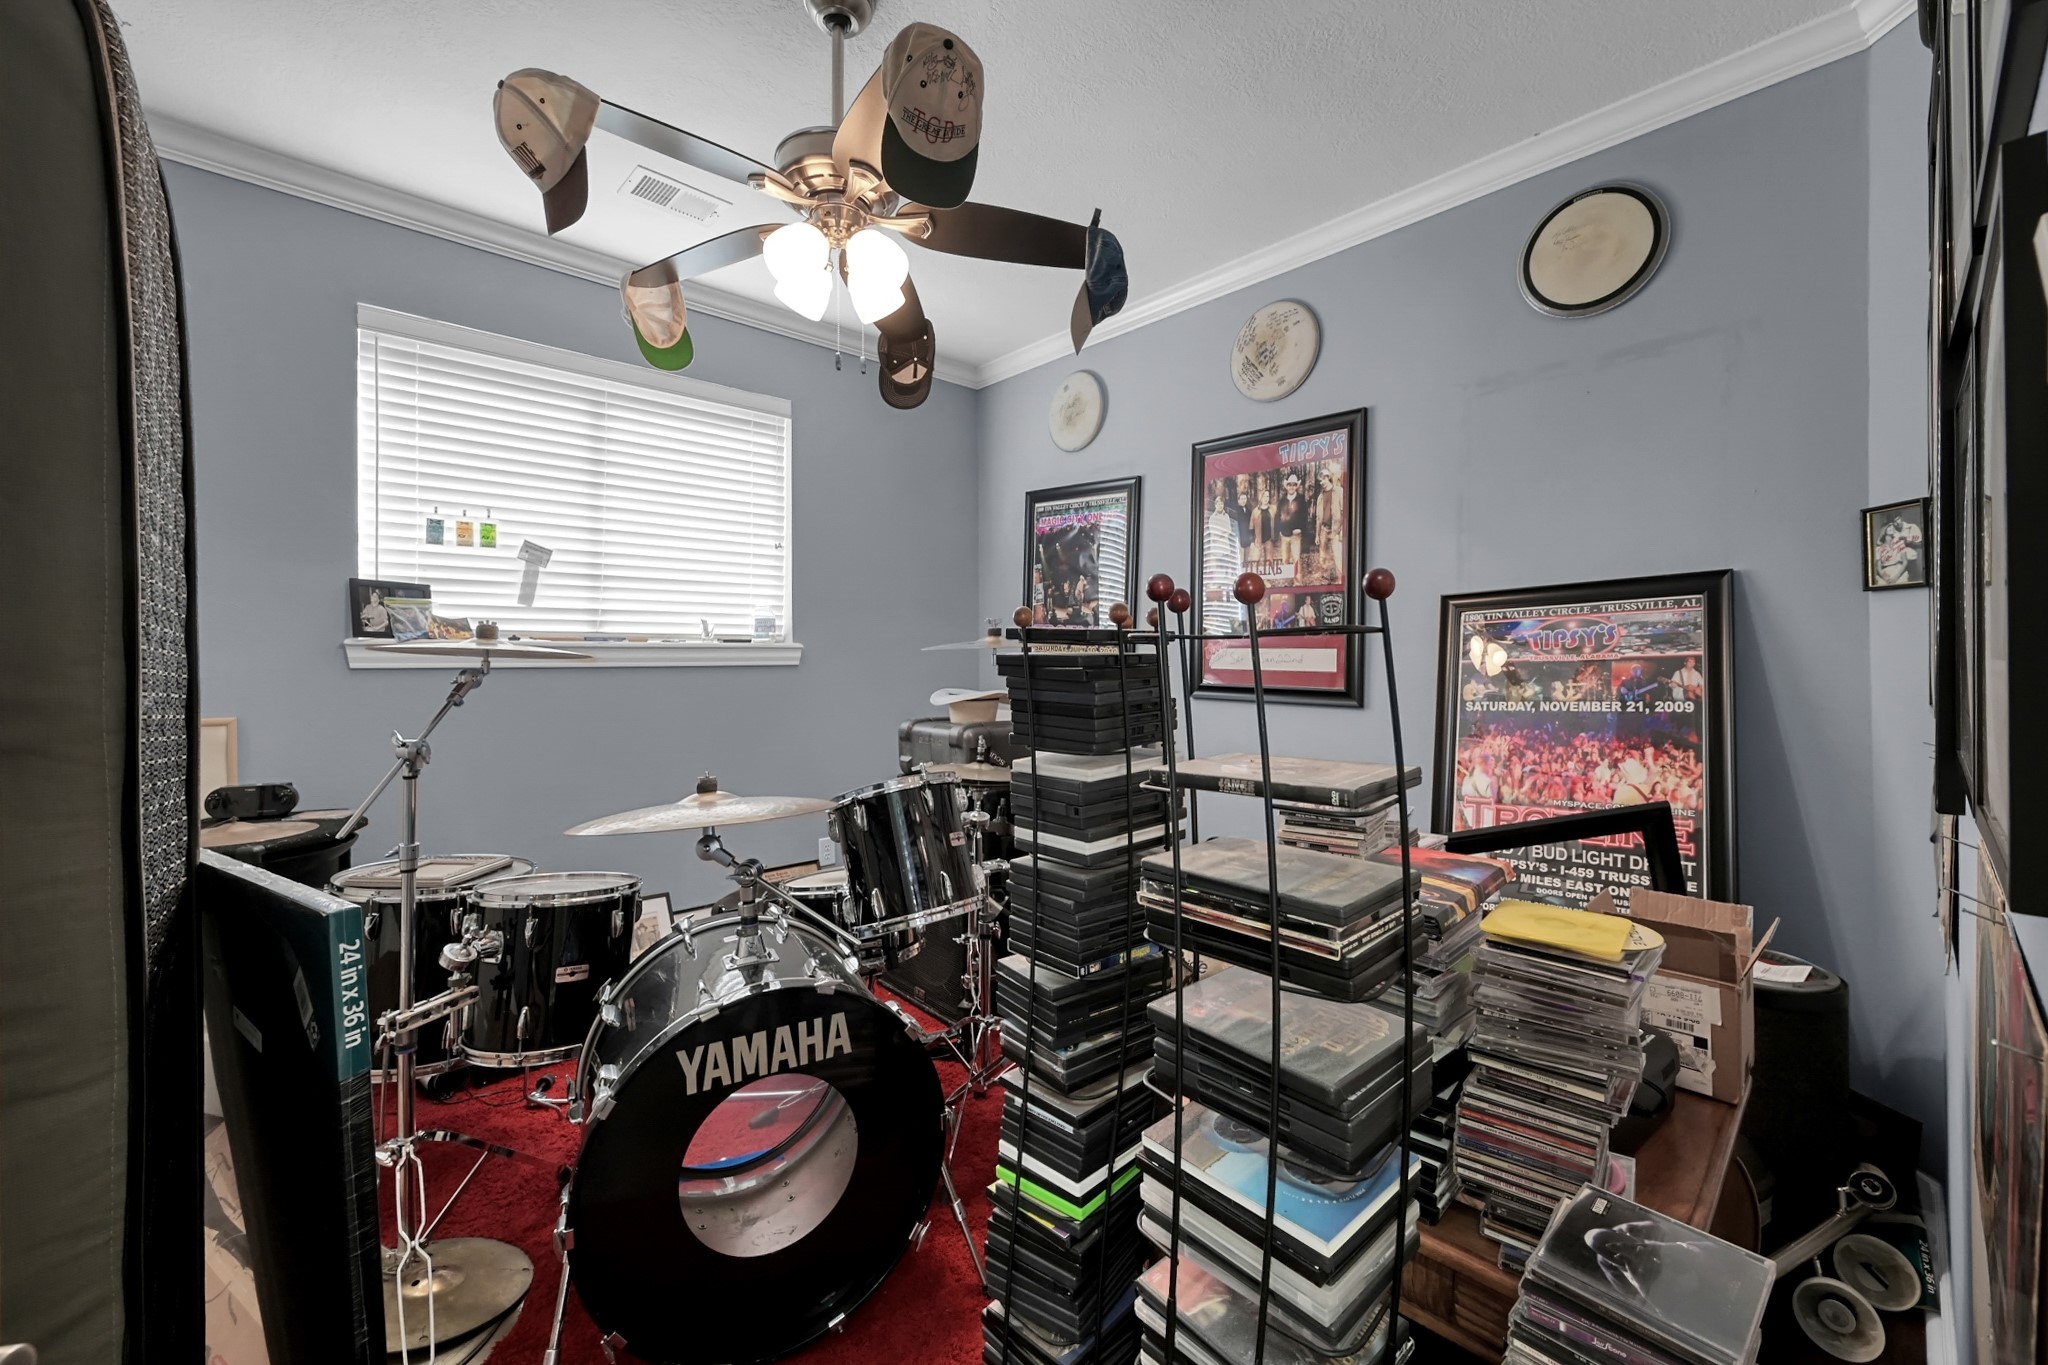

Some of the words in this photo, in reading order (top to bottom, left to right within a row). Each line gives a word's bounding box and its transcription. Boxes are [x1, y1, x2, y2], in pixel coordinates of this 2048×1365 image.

[902, 110, 916, 124] THE
[1278, 433, 1346, 465] TIPSY'S
[1484, 611, 1503, 620] TIN
[1505, 609, 1547, 619] VALLEY
[1549, 606, 1591, 616] CIRCLE
[1600, 600, 1678, 613] TRUSSVILLE,
[1681, 598, 1700, 607] AL
[1527, 623, 1617, 650] TIPSY'S
[1465, 701, 1536, 713] SATURDAY,
[1540, 700, 1622, 713] NOVEMBER
[1626, 700, 1650, 714] 21,
[1654, 700, 1695, 713] 2009
[1532, 845, 1568, 861] BUD
[1572, 848, 1626, 868] LIGHT
[1560, 865, 1595, 878] I-459
[1520, 873, 1561, 887] MILES
[1566, 879, 1604, 893] EAST
[1536, 887, 1564, 897] DOORS
[1565, 891, 1588, 900] OPEN
[338, 938, 361, 965] 24
[340, 964, 363, 987] in
[341, 986, 359, 1003] x
[342, 1000, 365, 1028] 36
[344, 1026, 367, 1050] in
[676, 1012, 852, 1096] YAMAHA
[1918, 1239, 1930, 1253] 24
[1921, 1252, 1931, 1262] in
[1923, 1262, 1931, 1271] x
[1924, 1270, 1935, 1285] 36
[1927, 1284, 1936, 1294] in
